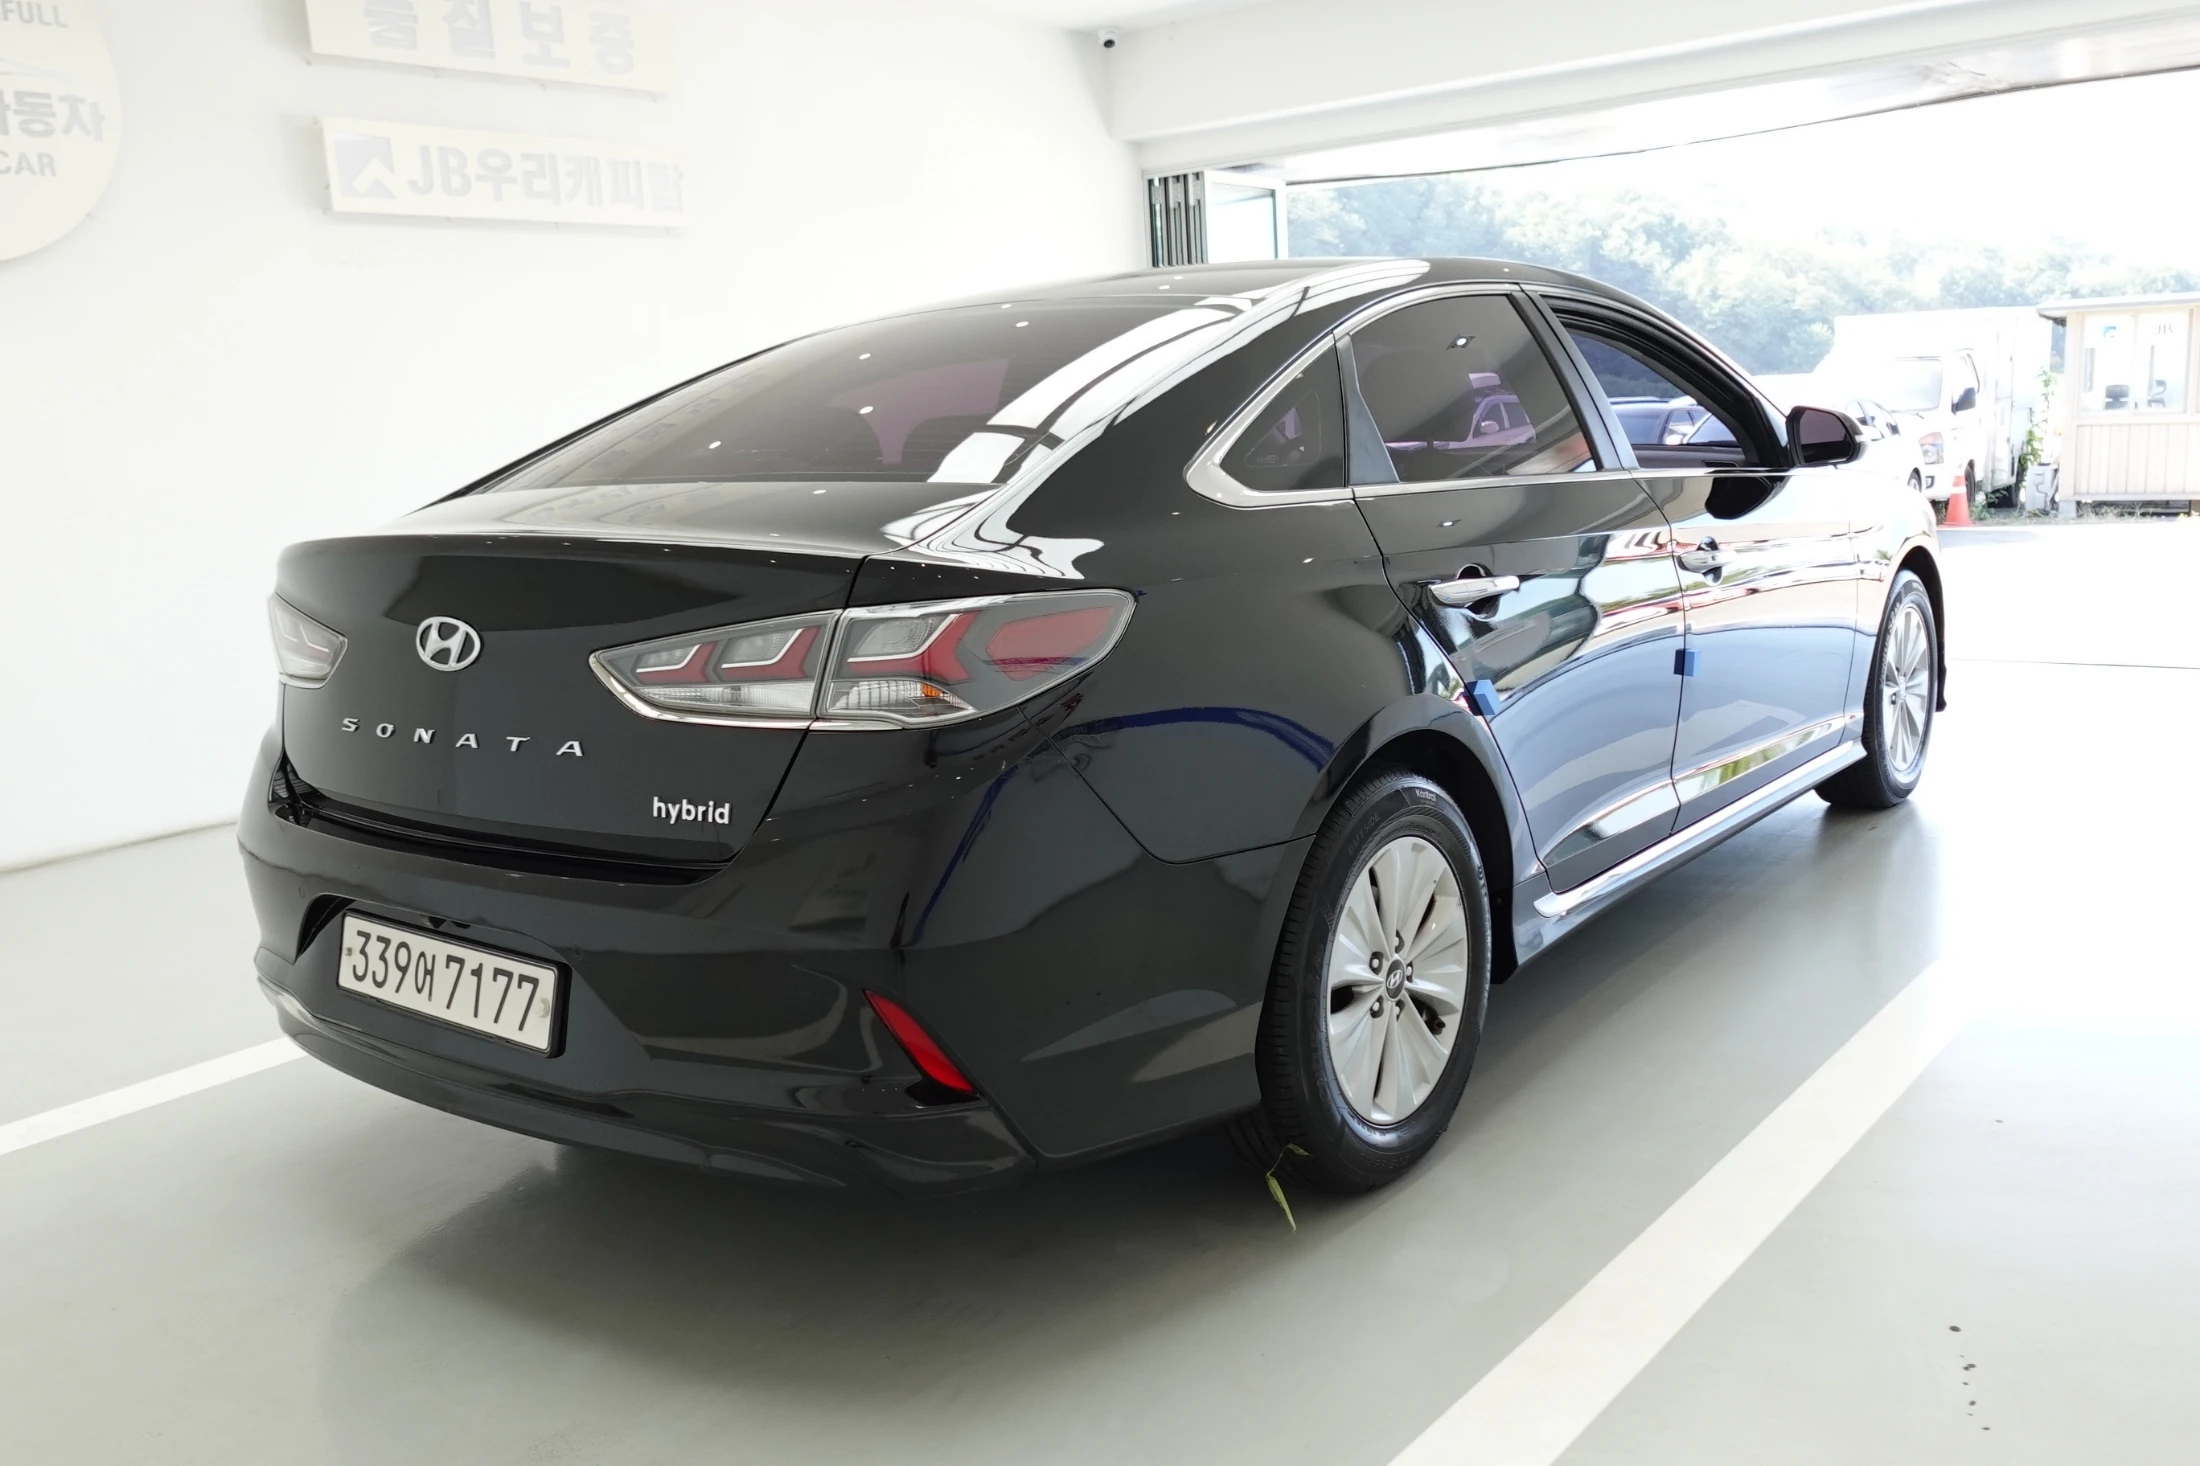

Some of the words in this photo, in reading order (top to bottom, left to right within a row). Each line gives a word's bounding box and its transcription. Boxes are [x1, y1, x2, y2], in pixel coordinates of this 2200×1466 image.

[0, 150, 57, 177] CAR
[341, 717, 583, 757] SONATA
[653, 796, 730, 824] hybrid
